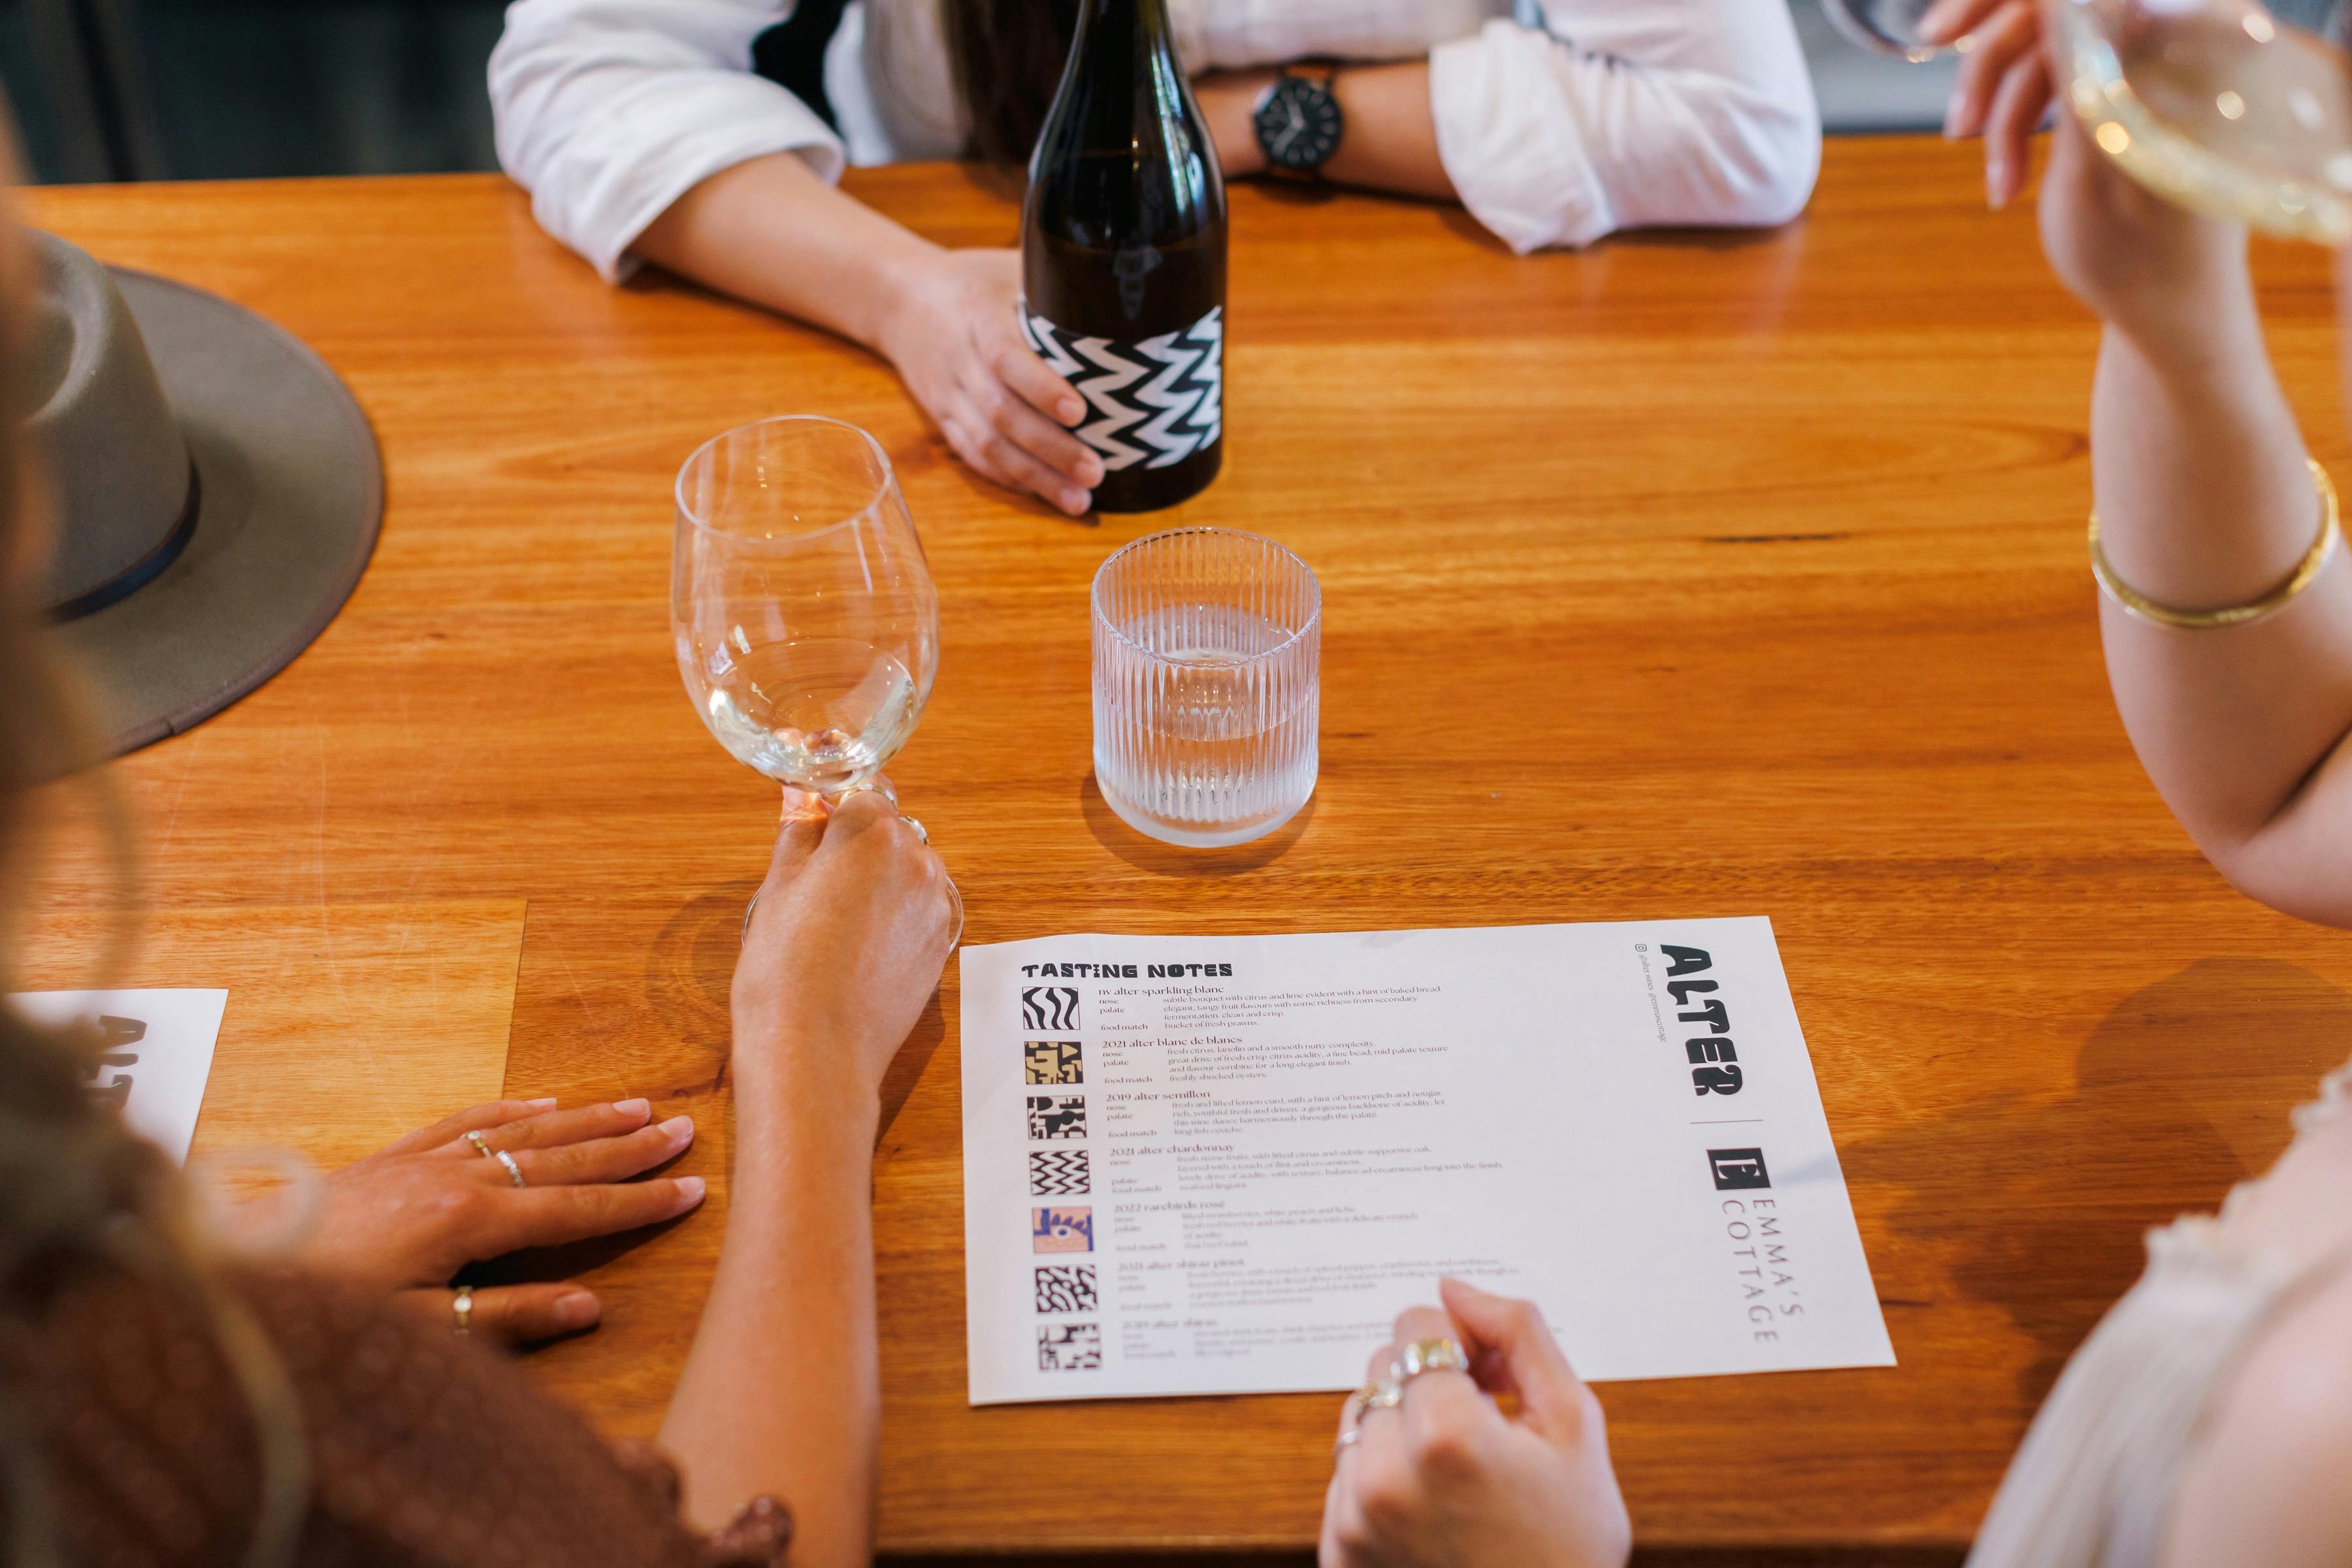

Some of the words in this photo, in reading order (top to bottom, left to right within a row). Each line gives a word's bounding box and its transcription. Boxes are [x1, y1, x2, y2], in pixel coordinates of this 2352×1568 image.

[1022, 963, 1137, 978] TASTING
[1147, 963, 1233, 977] NOTES
[1141, 986, 1193, 997] sparkling
[1162, 994, 1188, 1003] subtle
[1188, 994, 1224, 1003] bouquet
[1196, 1002, 1219, 1011] tangy
[1648, 992, 1667, 1043] @emmascottage
[1659, 944, 1743, 1096] ALTER
[1392, 1047, 1416, 1055] palate
[1103, 1059, 1128, 1068] palate
[1105, 1093, 1131, 1102] 2019
[1134, 1092, 1160, 1100] alter
[1162, 1090, 1210, 1099] semillon
[1109, 1147, 1134, 1156] 2021
[1137, 1146, 1163, 1154] alter
[1166, 1143, 1233, 1152] chardonnay
[1752, 1199, 1805, 1317] EMMA'S
[1722, 1200, 1780, 1343] COTTAGE
